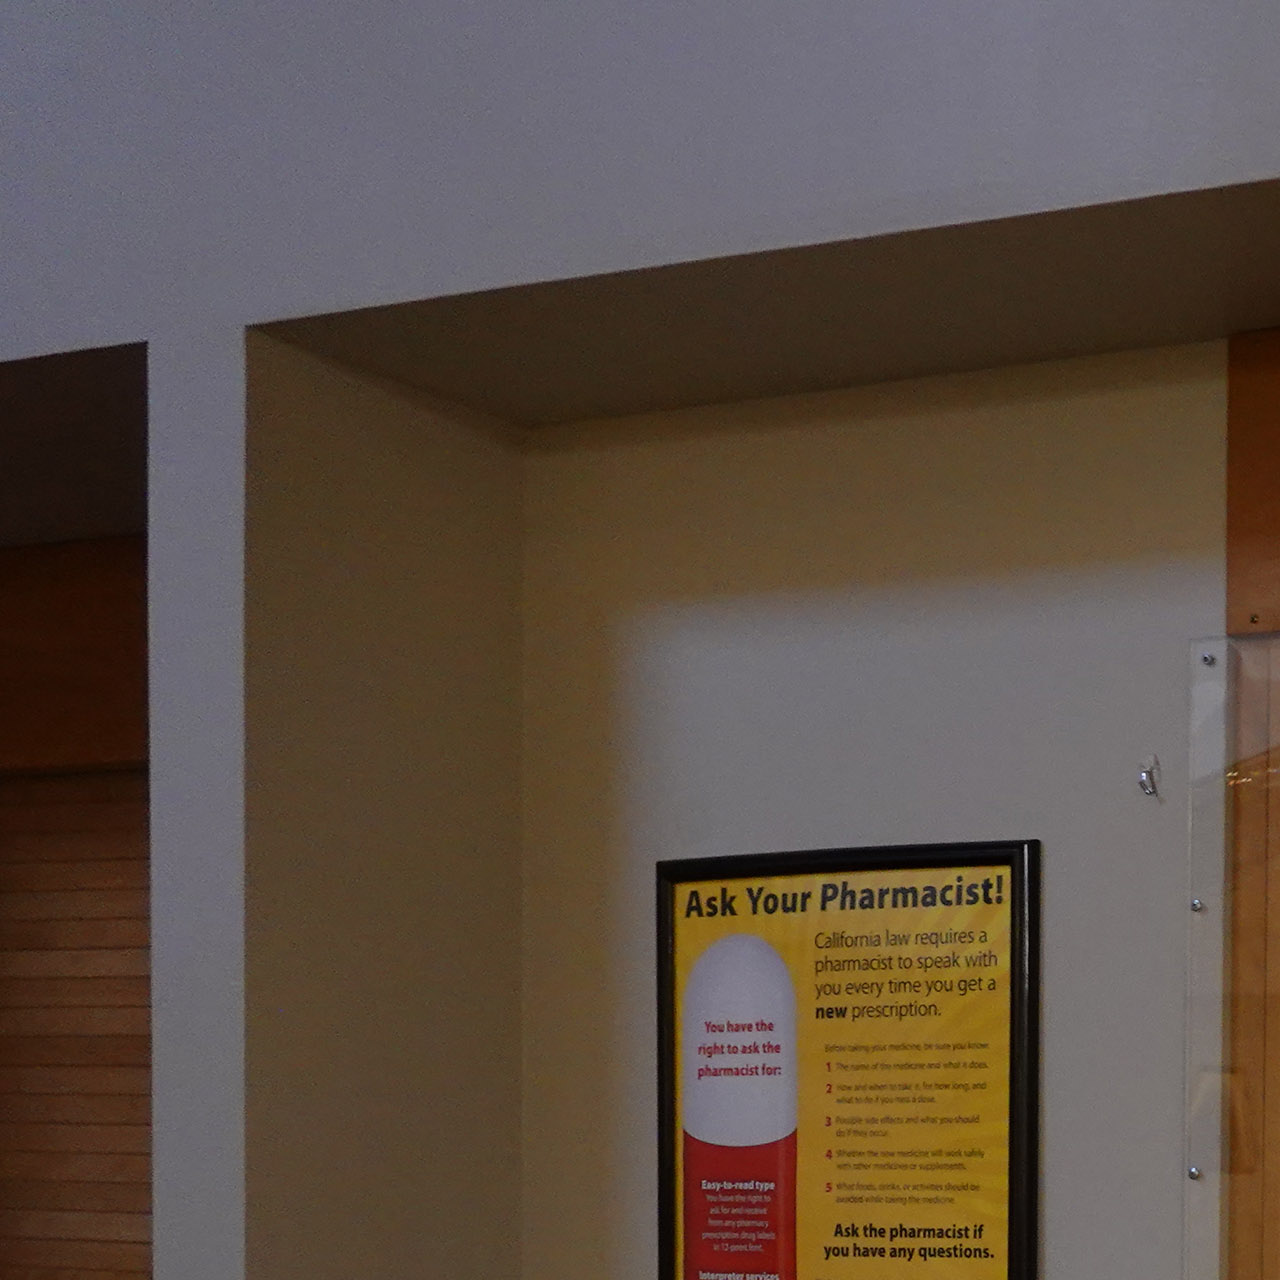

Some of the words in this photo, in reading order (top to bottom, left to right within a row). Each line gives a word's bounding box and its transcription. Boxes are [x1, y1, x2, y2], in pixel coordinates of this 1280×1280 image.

[685, 887, 737, 919] Ask
[746, 885, 812, 915] Your
[819, 875, 1004, 911] Pharmacist!
[814, 930, 881, 949] California
[885, 929, 911, 946] law
[915, 927, 974, 948] requires
[978, 931, 988, 943] a
[814, 952, 893, 975] pharmacist
[897, 954, 913, 970] to
[917, 951, 961, 972] speak
[964, 952, 998, 968] with
[815, 982, 841, 1000] you
[845, 981, 883, 999] every
[887, 979, 922, 994] time
[925, 980, 954, 997] you
[957, 978, 983, 996] get
[987, 979, 997, 992] a
[815, 1006, 847, 1020] new
[852, 1002, 942, 1022] prescription.
[704, 1020, 725, 1034] You
[727, 1019, 752, 1033] have
[754, 1019, 774, 1032] the
[697, 1042, 725, 1057] right
[727, 1043, 738, 1055] to
[740, 1042, 759, 1054] ask
[762, 1042, 781, 1054] the
[697, 1064, 759, 1079] pharmacist
[762, 1064, 782, 1077] for:
[826, 1062, 832, 1072] 1
[826, 1084, 832, 1094] 2
[825, 1116, 832, 1126] 3
[825, 1150, 833, 1160] 4
[755, 1181, 776, 1193] type
[825, 1183, 832, 1192] 5
[833, 1223, 859, 1238] Ask
[863, 1223, 886, 1238] the
[889, 1224, 970, 1242] pharmacist
[973, 1224, 984, 1239] if
[824, 1245, 849, 1260] you
[853, 1243, 886, 1258] have
[889, 1245, 916, 1262] any
[918, 1243, 995, 1261] questions.
